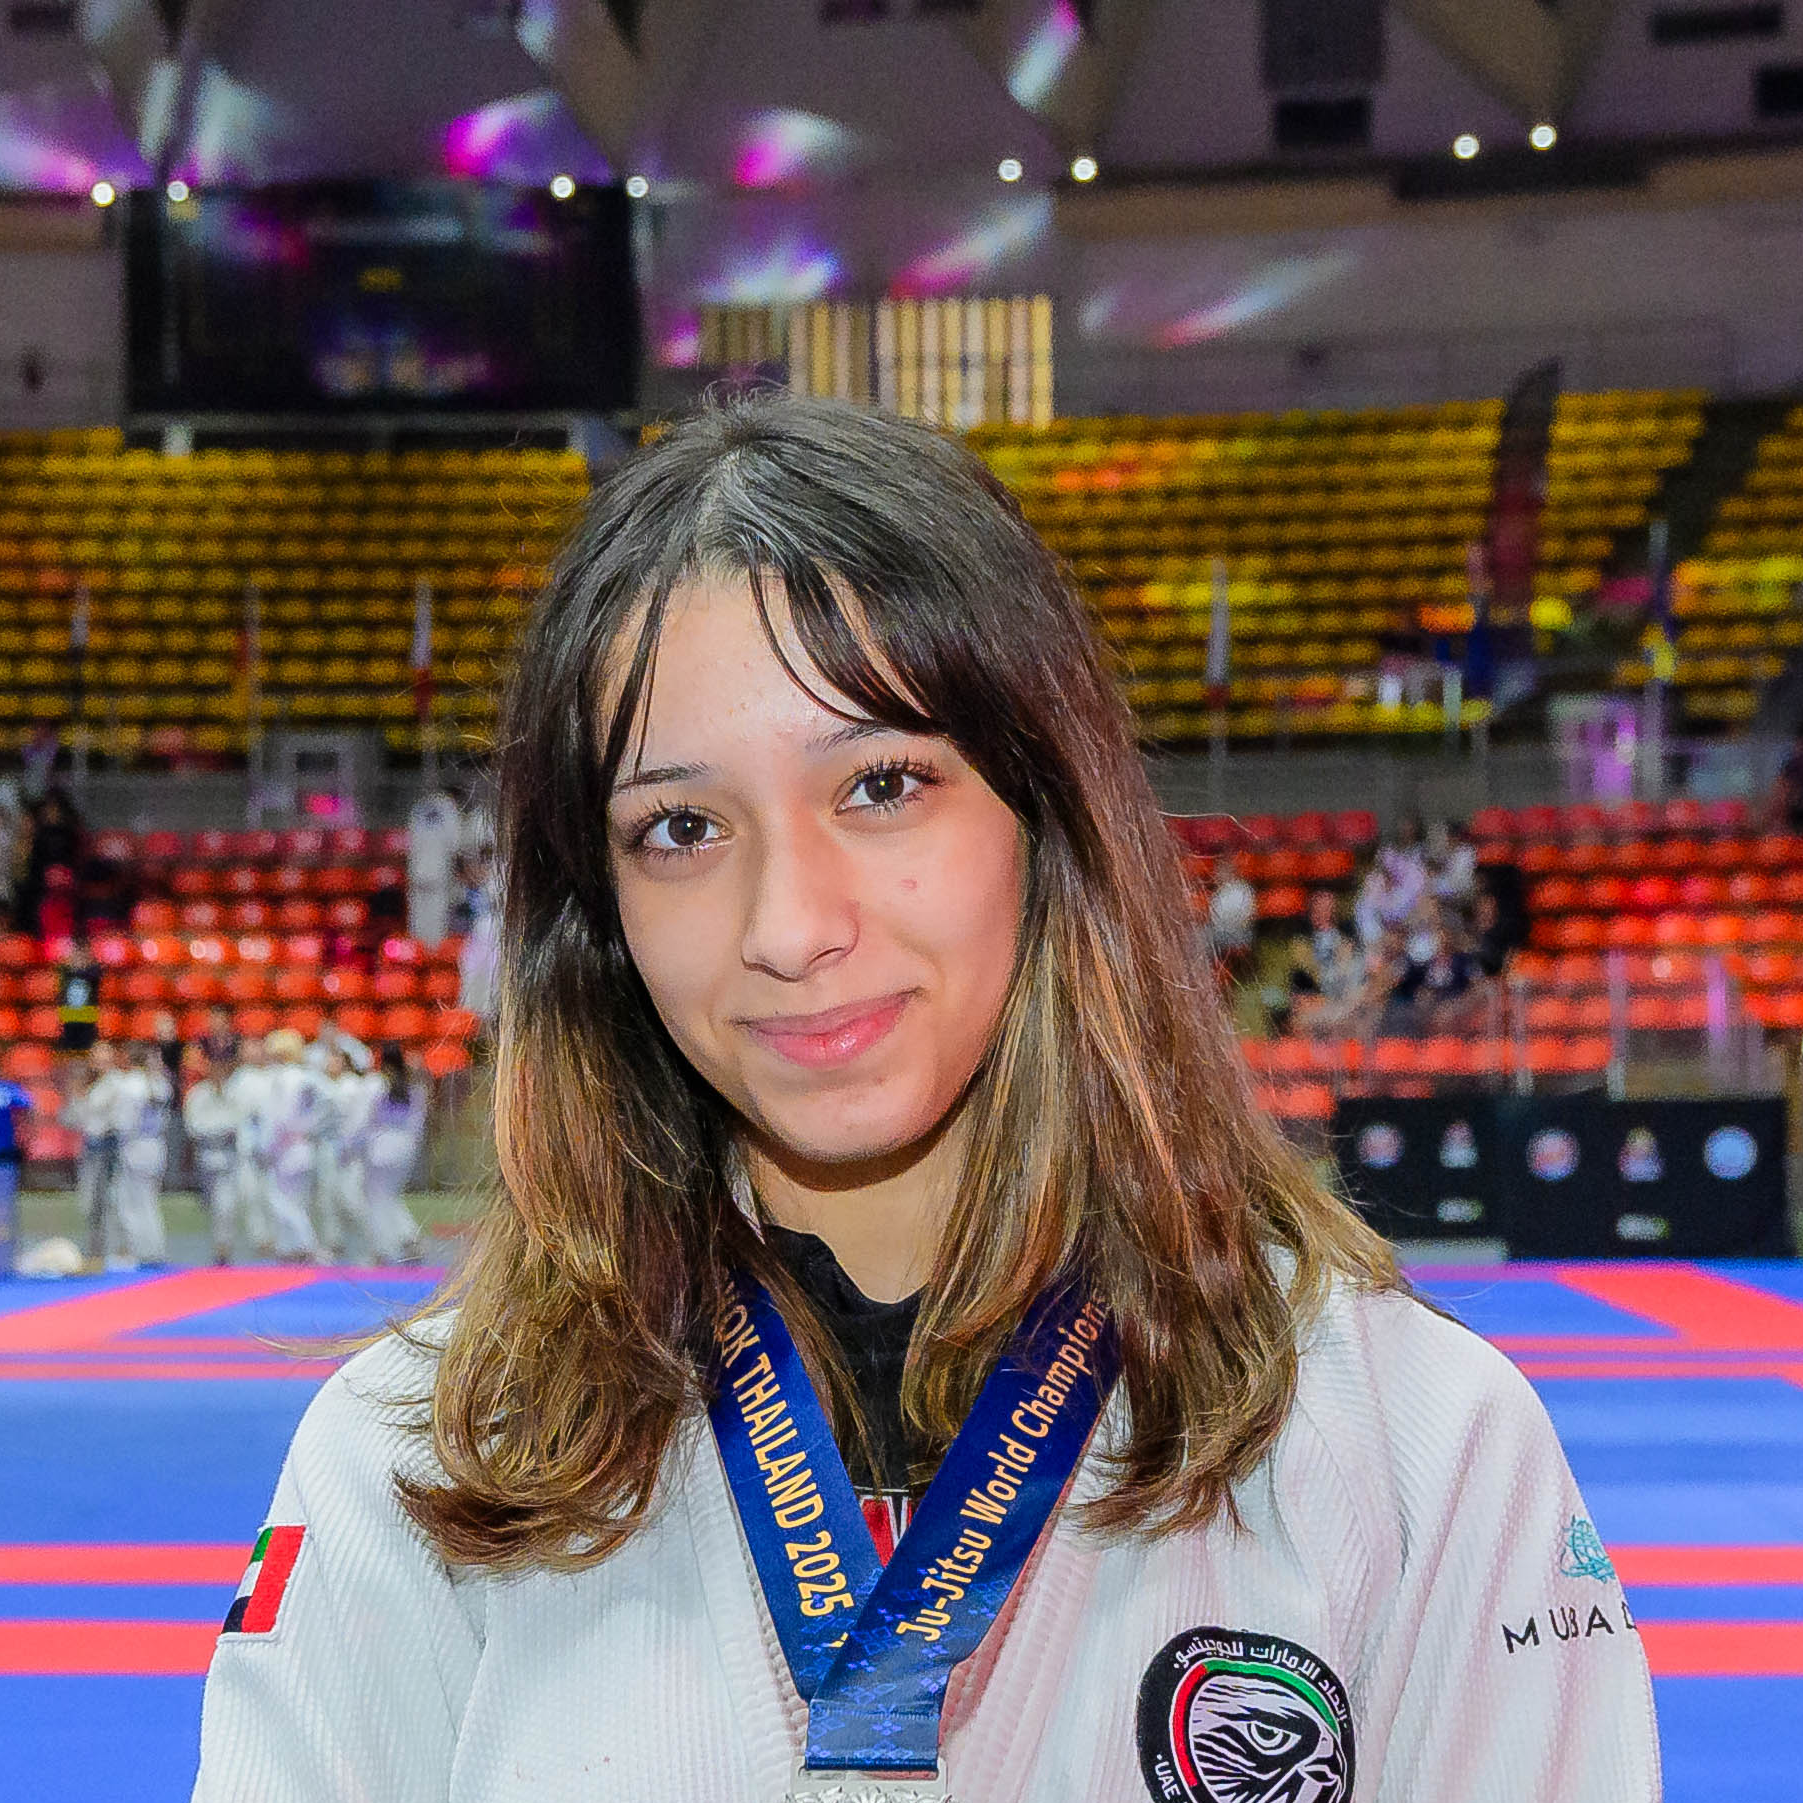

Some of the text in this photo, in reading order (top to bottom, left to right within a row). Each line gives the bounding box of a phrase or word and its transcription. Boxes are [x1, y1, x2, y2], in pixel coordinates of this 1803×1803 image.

[733, 1352, 824, 1529] THAILAND
[785, 1530, 854, 1617] 2025
[896, 1529, 992, 1642] Ju-Jitsu
[960, 1434, 1037, 1525] World
[1155, 1762, 1180, 1801] UAE
